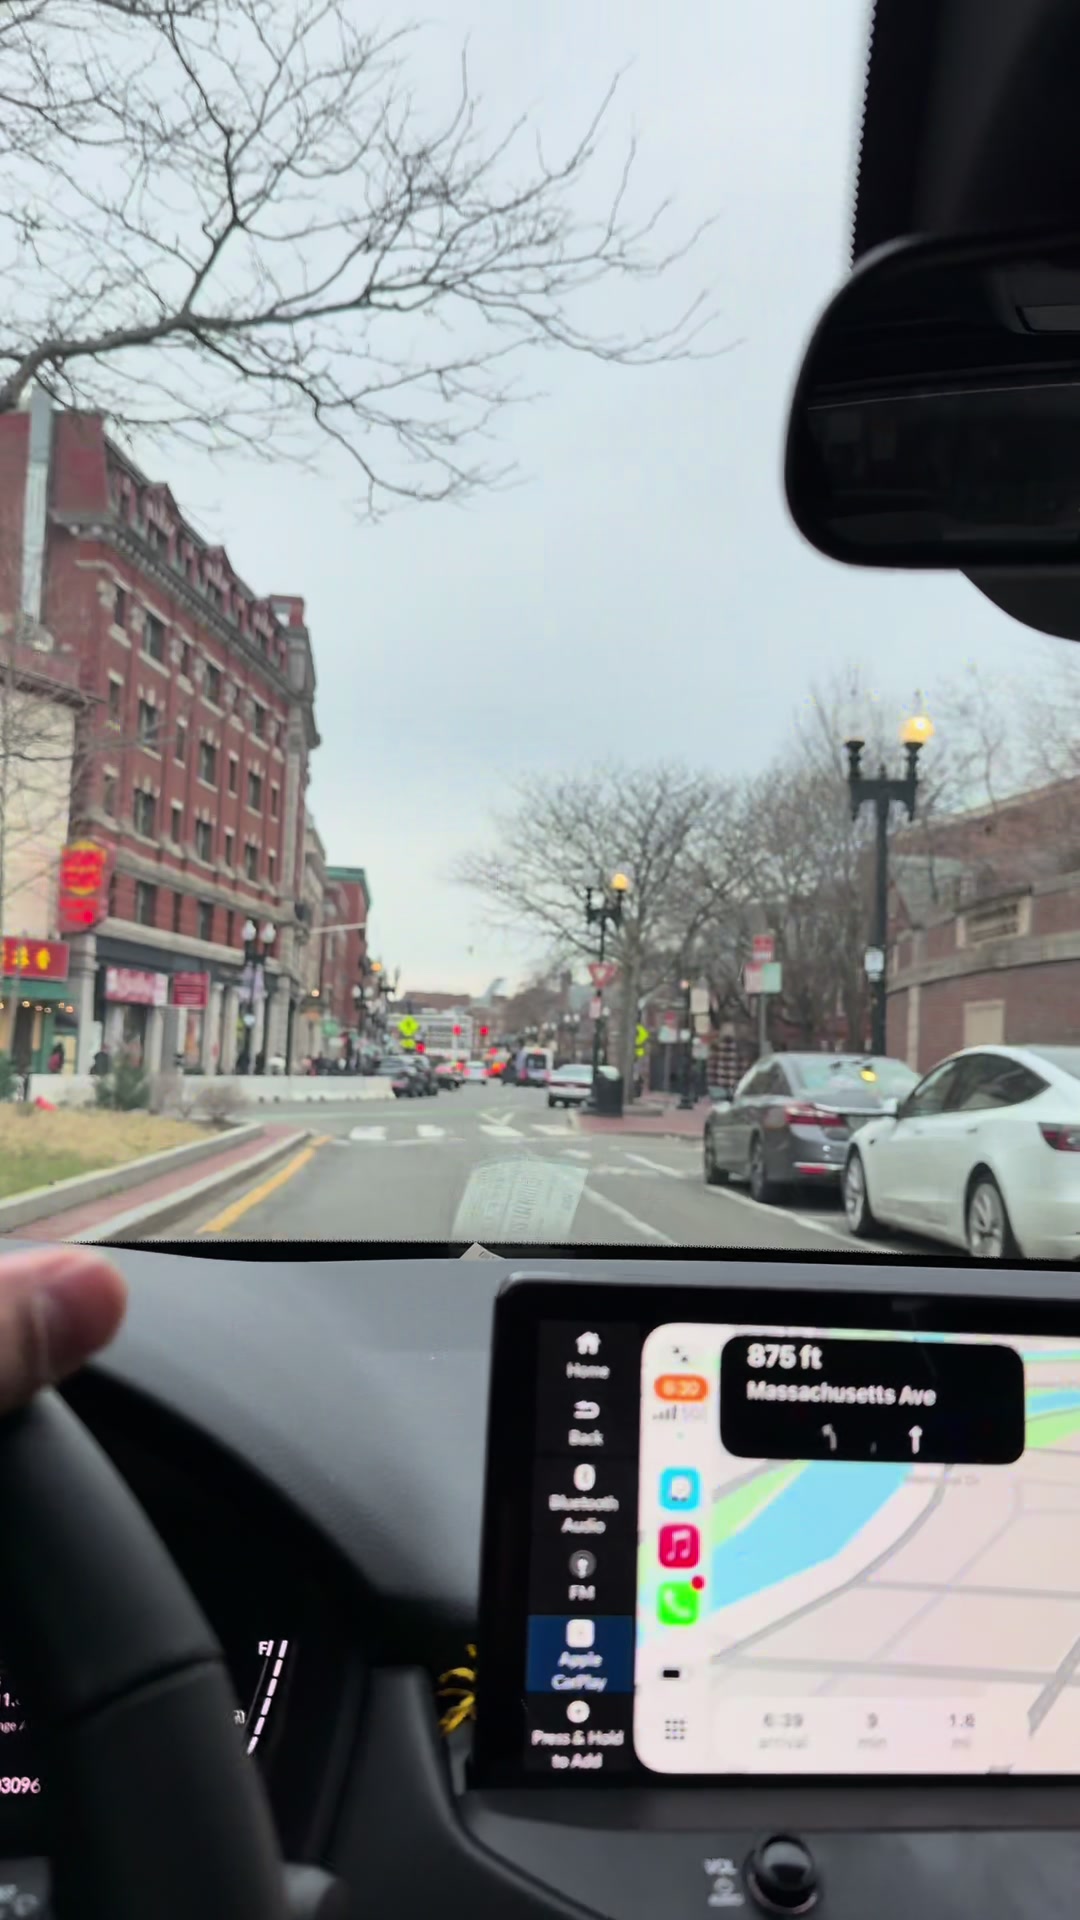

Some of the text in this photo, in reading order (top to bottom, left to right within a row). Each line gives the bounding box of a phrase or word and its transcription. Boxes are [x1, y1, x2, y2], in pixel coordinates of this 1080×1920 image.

[747, 1343, 823, 1369] 875 ft
[566, 1361, 610, 1379] Home
[746, 1380, 937, 1407] Massachusetts Ave
[568, 1429, 604, 1446] Back
[549, 1494, 619, 1511] Bluetooth
[561, 1517, 606, 1534] Audio
[569, 1585, 596, 1600] FM
[258, 1641, 268, 1655] F
[558, 1651, 603, 1669] Apple
[551, 1674, 608, 1692] CarPlay
[531, 1729, 571, 1746] Press
[587, 1730, 624, 1746] Hold
[551, 1753, 603, 1769] to Add
[0, 1776, 41, 1794] 3096
